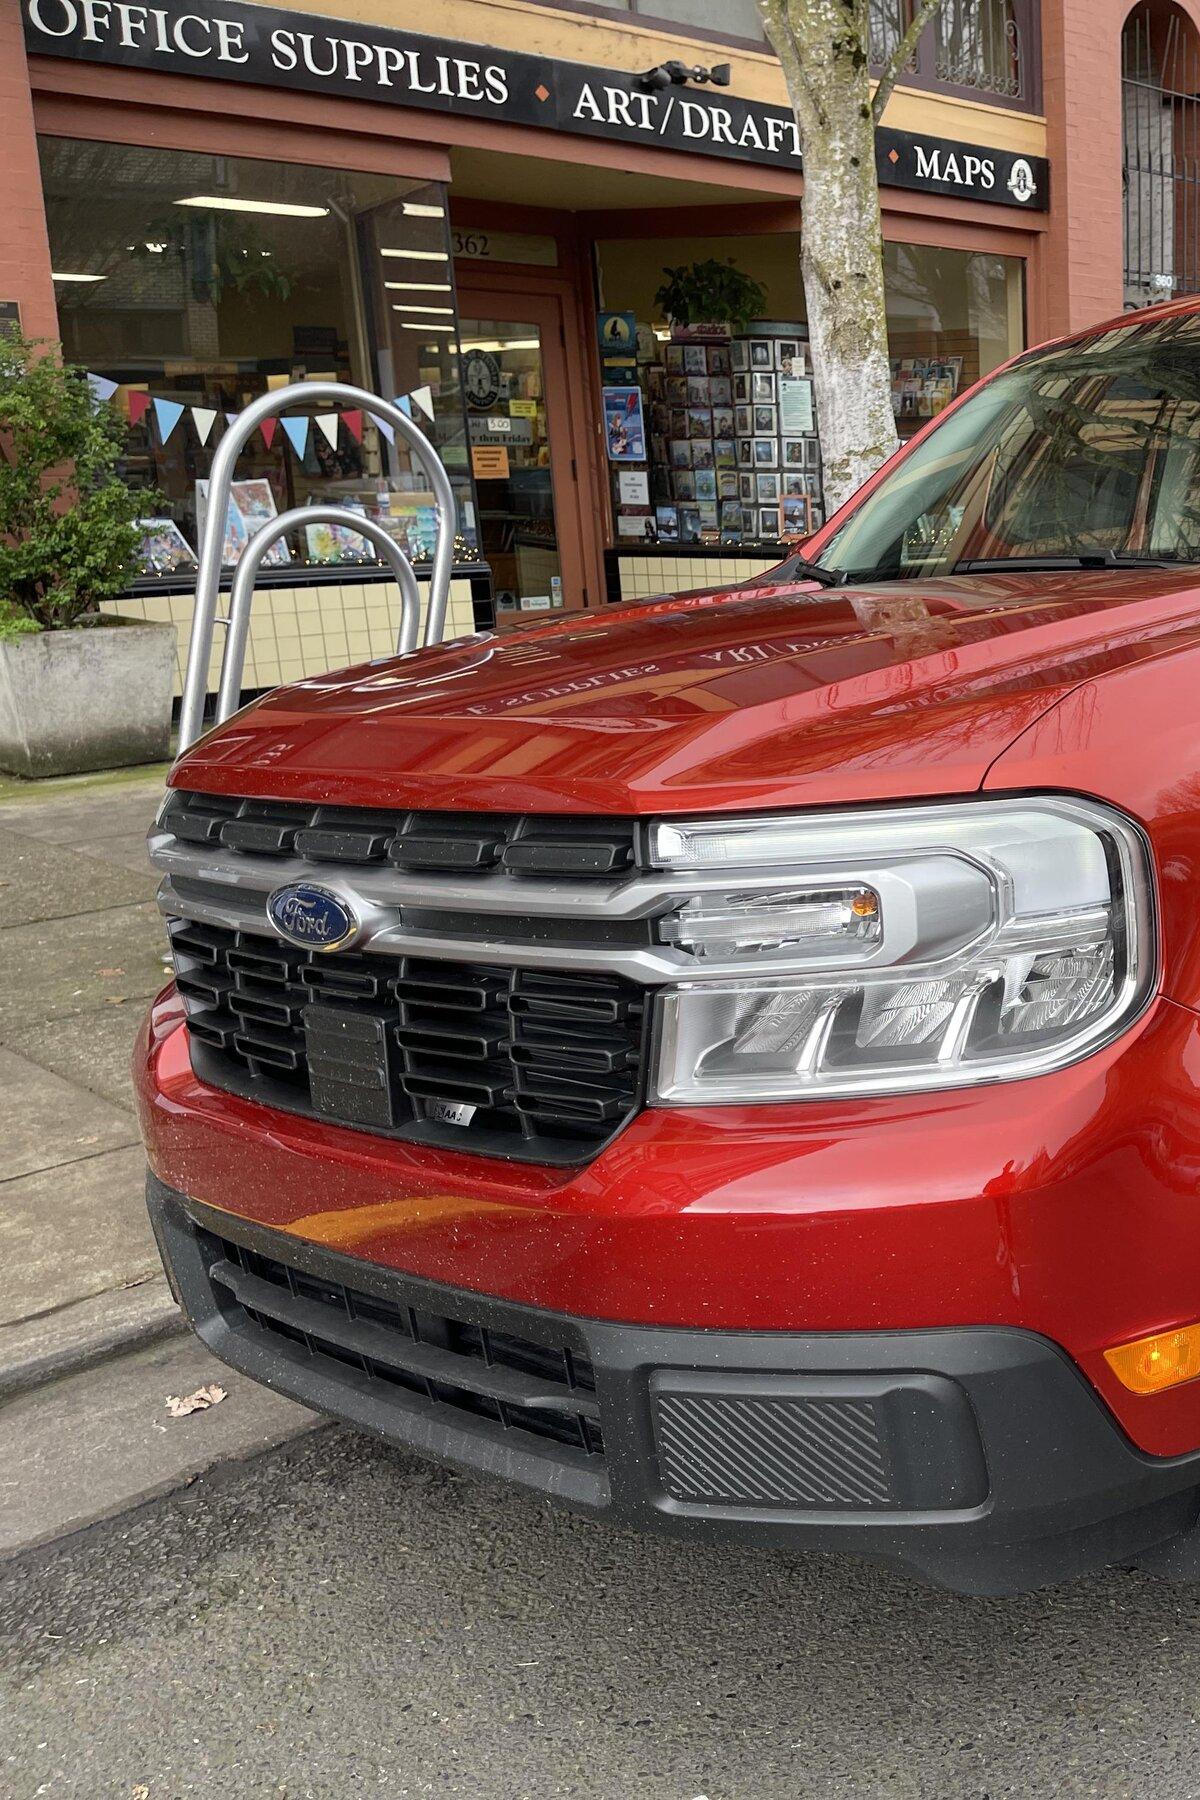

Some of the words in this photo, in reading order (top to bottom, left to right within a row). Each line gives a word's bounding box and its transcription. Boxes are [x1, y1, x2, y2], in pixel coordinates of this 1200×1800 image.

[29, 0, 249, 64] OFFICE
[271, 29, 509, 104] SUPPLIES
[914, 145, 995, 190] MAPS
[452, 232, 490, 256] 362
[1154, 274, 1173, 287] 360
[284, 897, 332, 936] Ford
